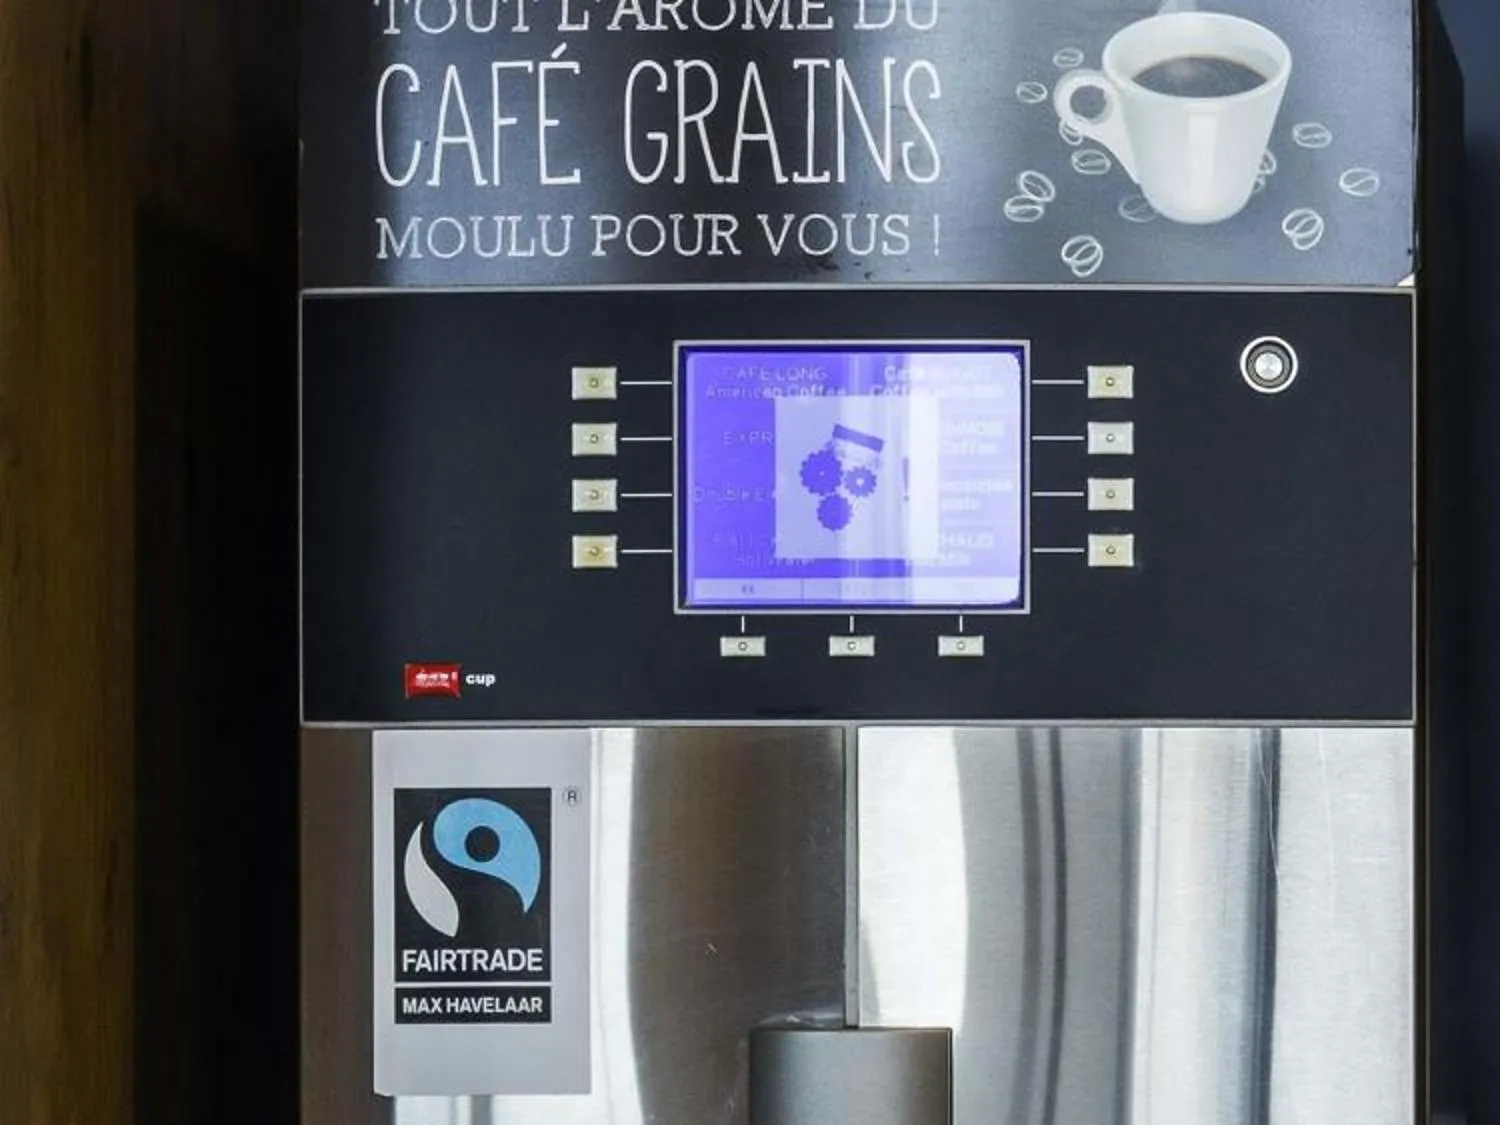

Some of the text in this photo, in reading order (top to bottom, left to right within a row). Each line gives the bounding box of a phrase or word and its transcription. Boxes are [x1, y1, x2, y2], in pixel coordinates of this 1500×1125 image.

[374, 0, 939, 34] TOUT LAROME DU
[375, 43, 941, 187] CAFÉ GRAINS
[375, 216, 574, 259] MOULU
[591, 214, 741, 257] POUR
[757, 214, 911, 257] VOUS
[465, 674, 497, 687] cup
[402, 948, 544, 973] FAIRTRADE
[402, 997, 543, 1014] MAX HAVELAAR
